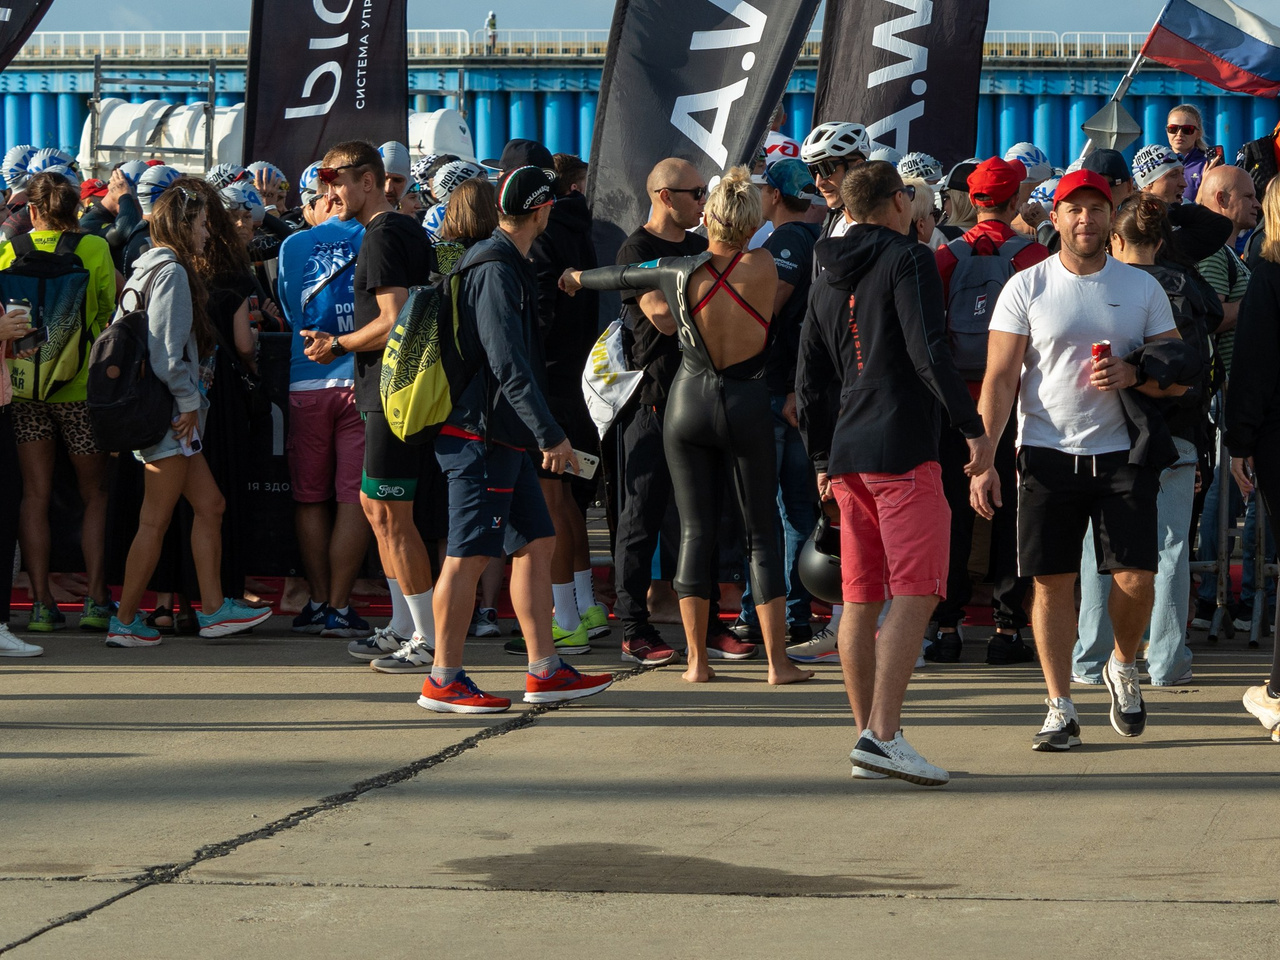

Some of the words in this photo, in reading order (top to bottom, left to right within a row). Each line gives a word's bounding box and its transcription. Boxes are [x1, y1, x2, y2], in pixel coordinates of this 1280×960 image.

[355, 33, 371, 110] СИСТЕМА
[900, 158, 919, 172] IRON
[1135, 148, 1154, 165] IRON
[439, 172, 459, 190] IRON
